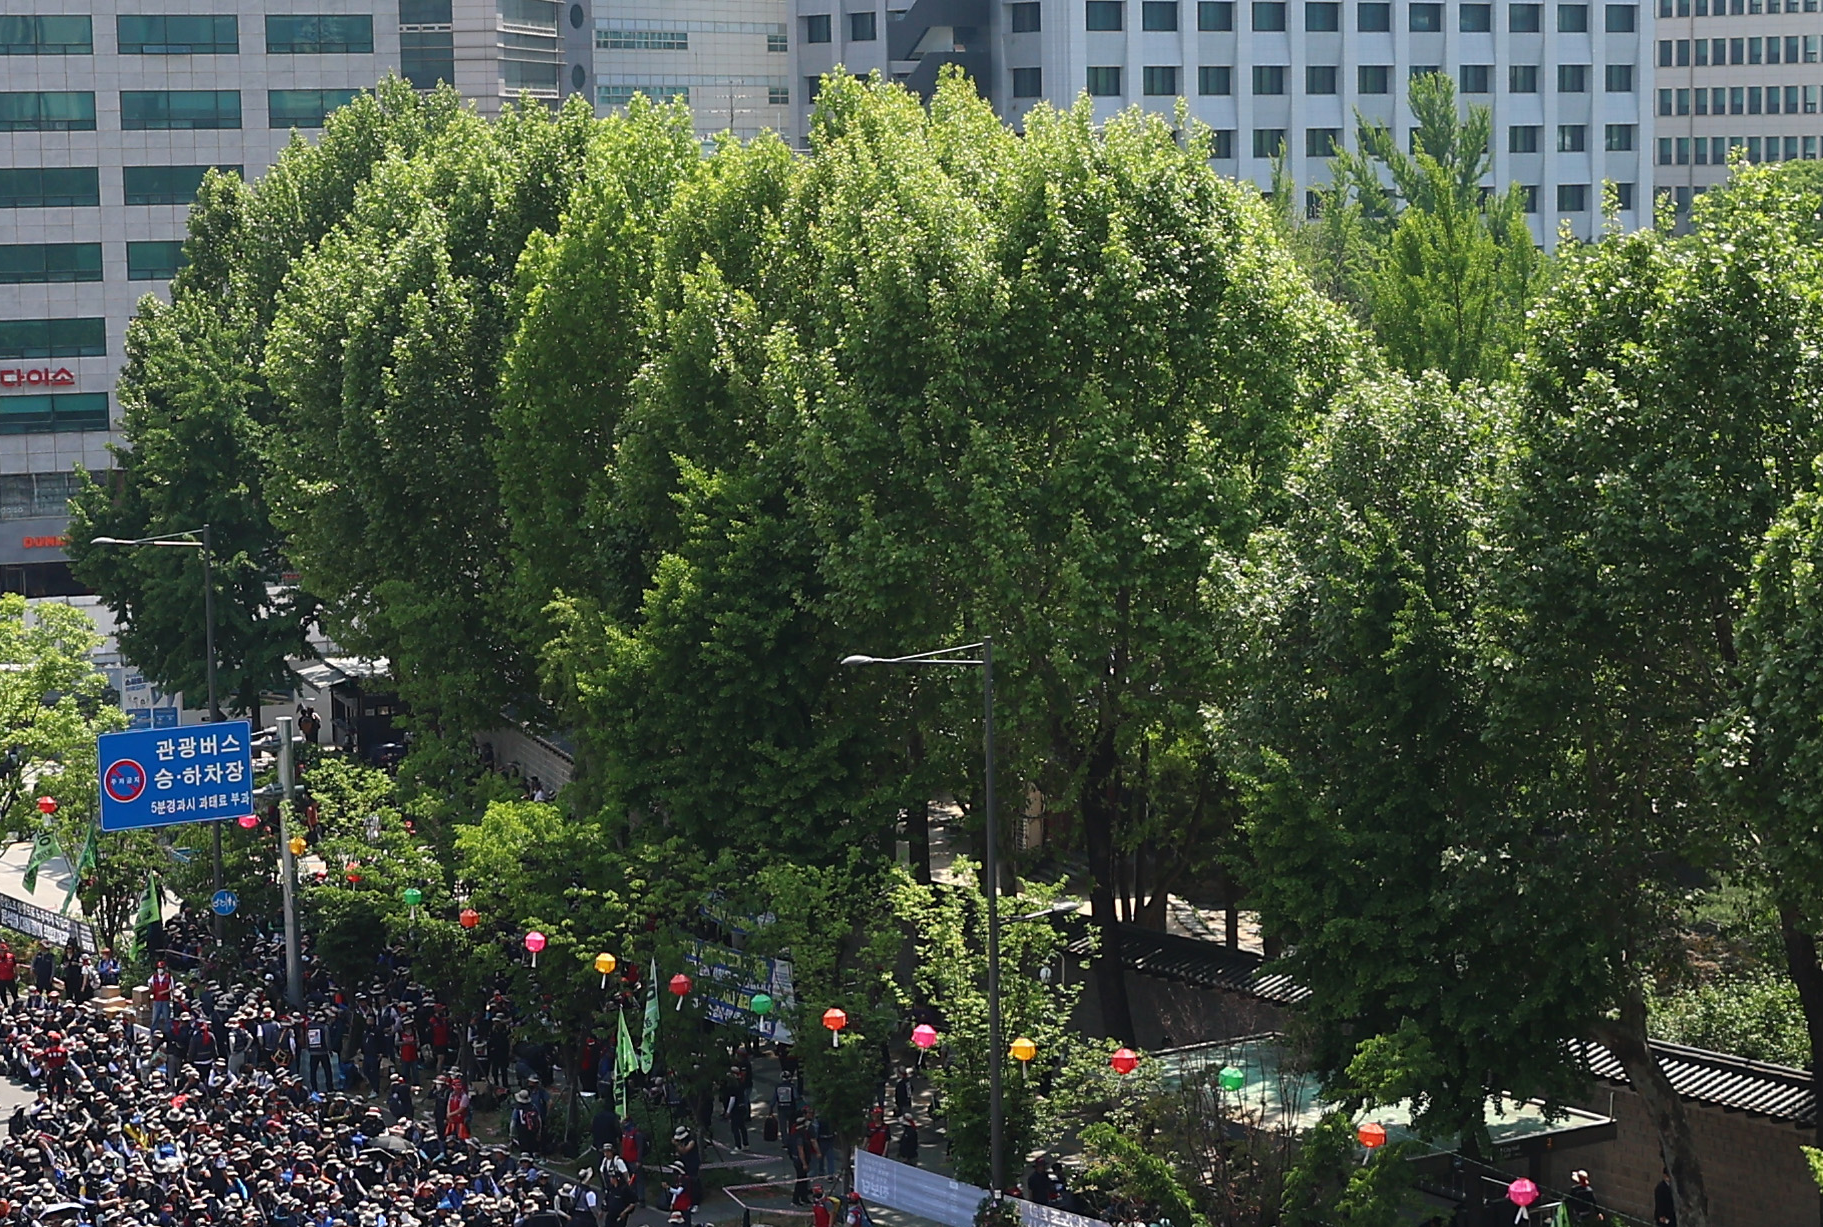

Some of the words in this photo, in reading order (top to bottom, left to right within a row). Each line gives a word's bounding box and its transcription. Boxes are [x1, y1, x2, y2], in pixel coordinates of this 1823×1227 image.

[0, 367, 75, 387] 다이소
[155, 734, 241, 761] 관광버스
[153, 760, 245, 790] 승·하차장
[150, 796, 196, 815] 5분경과시
[198, 794, 228, 810] 과태료
[230, 791, 251, 806] 부과
